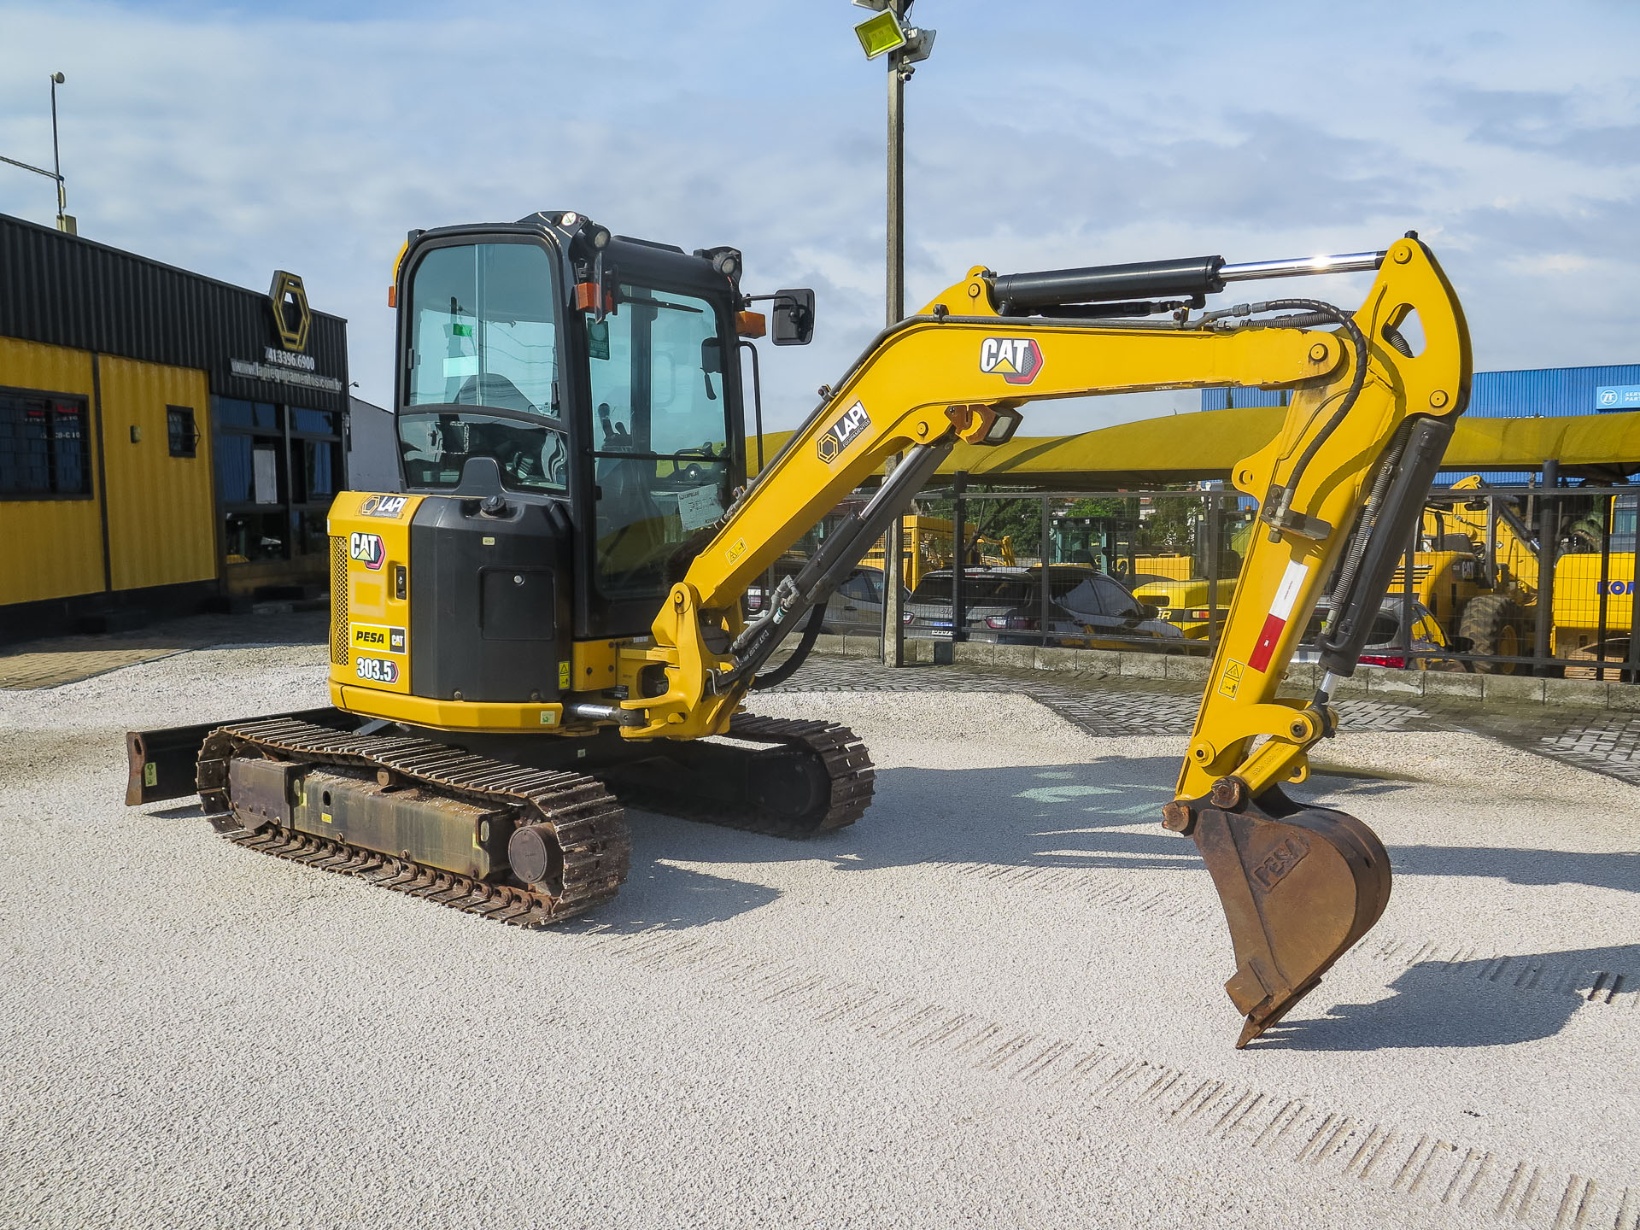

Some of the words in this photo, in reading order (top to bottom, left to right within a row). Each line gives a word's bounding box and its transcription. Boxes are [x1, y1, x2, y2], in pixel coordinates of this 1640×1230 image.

[981, 338, 1029, 374] CAT
[833, 401, 867, 442] LAPI
[378, 496, 407, 512] LAPI
[350, 532, 378, 561] CAT
[1461, 561, 1475, 579] CAT
[356, 630, 385, 644] PESA
[391, 634, 404, 647] CAT
[357, 657, 392, 682] 303.5
